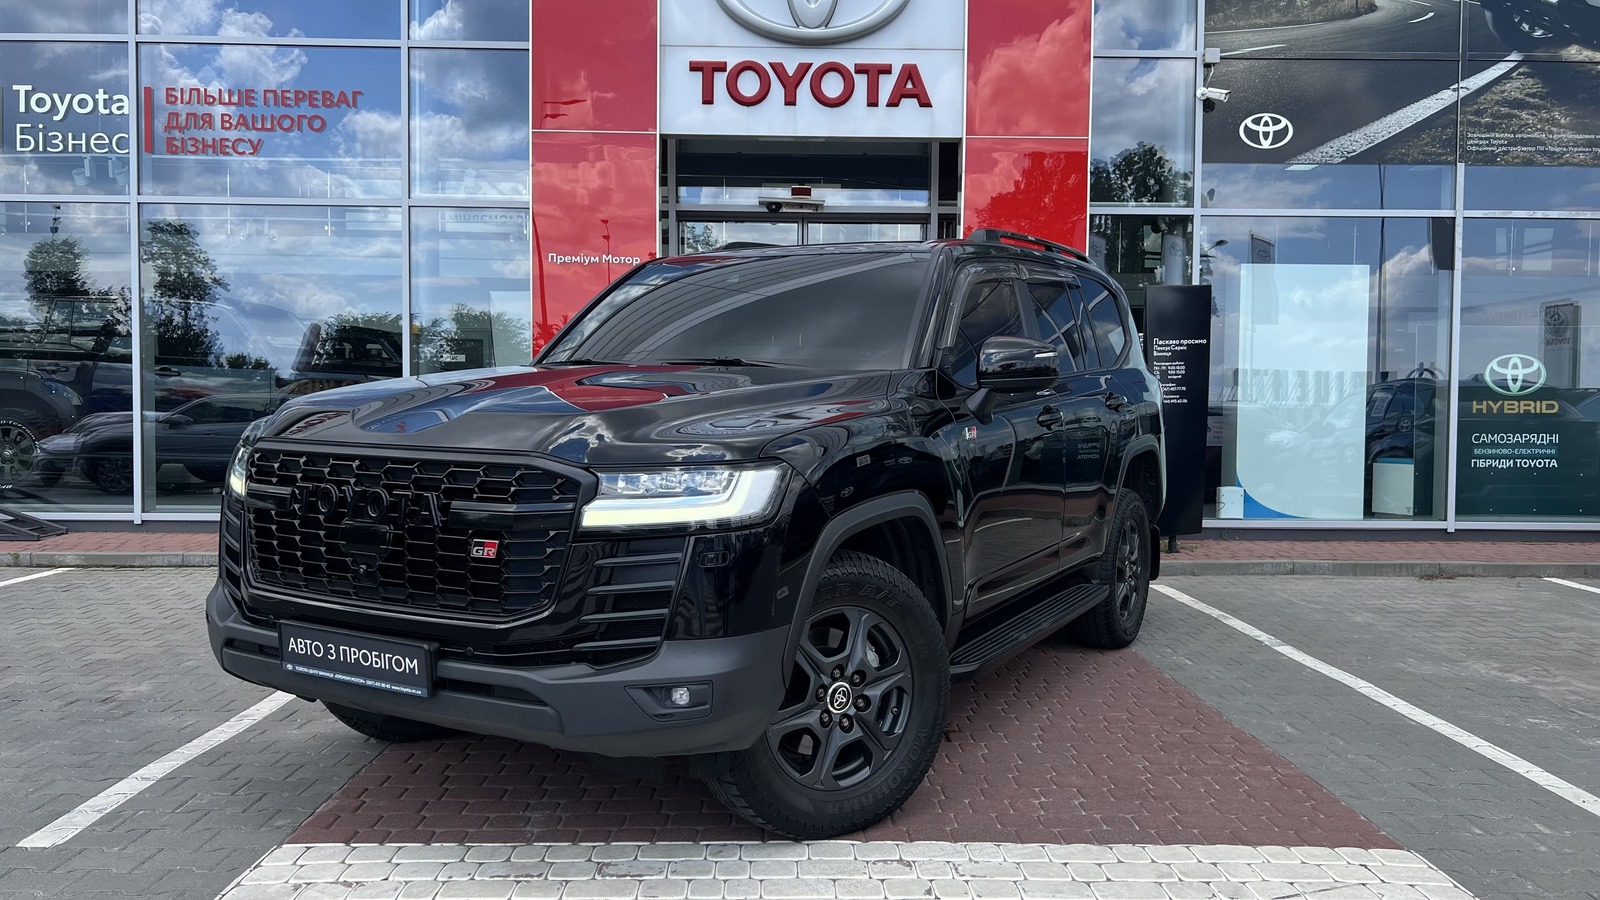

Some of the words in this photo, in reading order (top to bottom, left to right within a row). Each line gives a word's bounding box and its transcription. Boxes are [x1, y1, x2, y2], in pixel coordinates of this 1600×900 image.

[689, 60, 933, 108] TOYOTA
[12, 85, 129, 120] Toyota
[165, 87, 256, 108] БІЛЬШЕ
[263, 89, 363, 109] ПЕРЕВАГ
[164, 112, 216, 132] ДЛЯ
[220, 113, 327, 133] ВАШОГО
[15, 123, 129, 154] Бізнес
[165, 136, 263, 156] БІЗНЕСУ
[548, 253, 599, 266] Преміум
[602, 254, 641, 267] Мотор
[1472, 400, 1559, 414] HYBRID
[1472, 433, 1559, 445] САМОЗАРЯДНІ
[1471, 459, 1514, 469] ГІБРИДИ
[1515, 459, 1558, 468] TOYOTA
[288, 637, 324, 658] АВТО
[327, 644, 336, 660] З
[340, 646, 418, 675] ПРОБІГОМ
